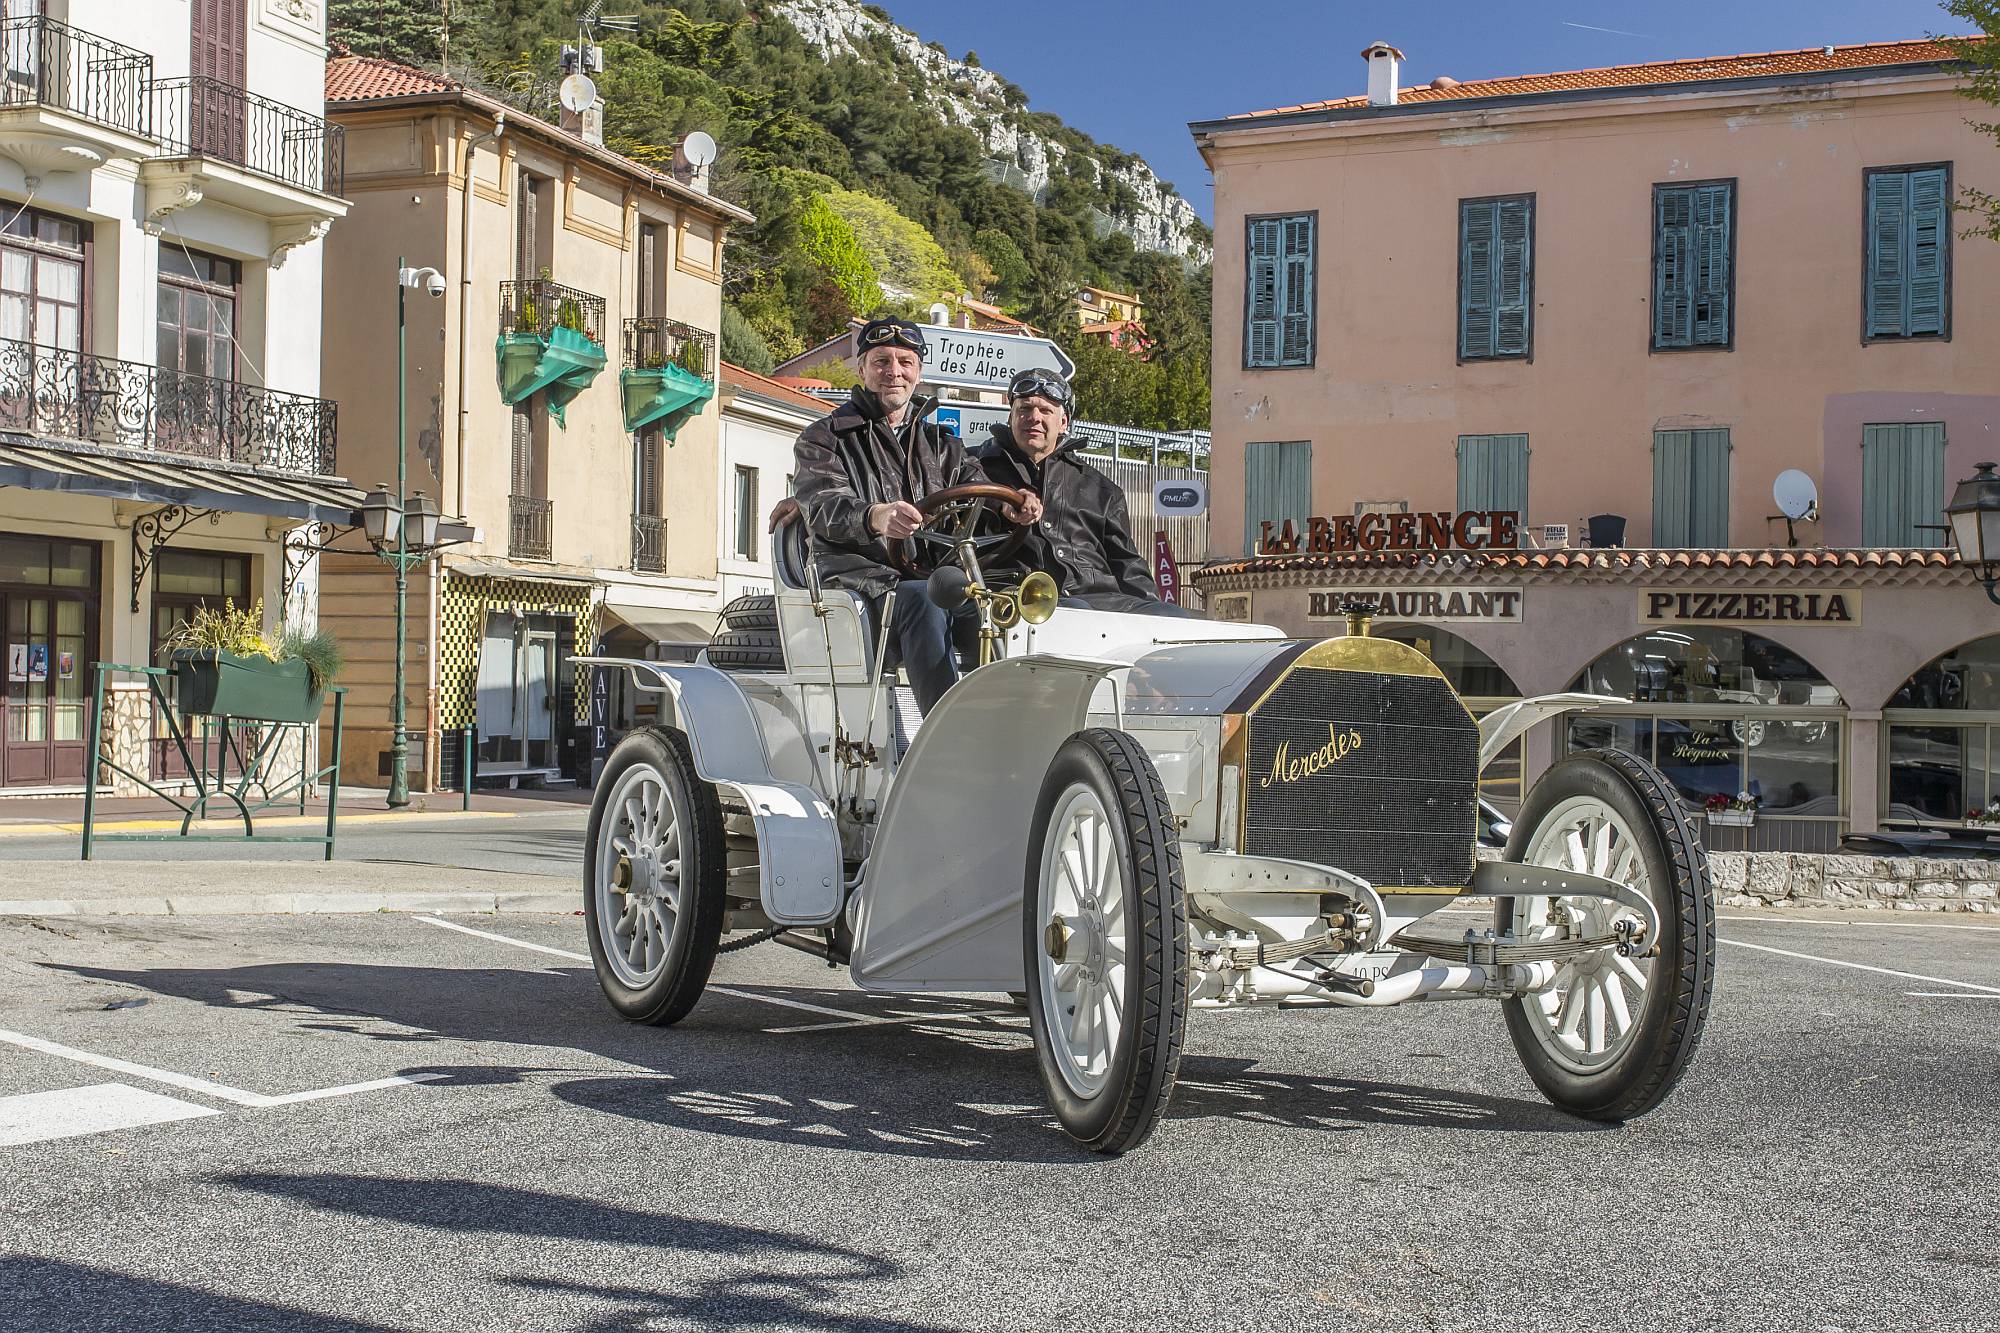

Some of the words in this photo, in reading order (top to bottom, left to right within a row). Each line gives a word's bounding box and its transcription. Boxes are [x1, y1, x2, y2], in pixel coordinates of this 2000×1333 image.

[940, 338, 1004, 360] Trophée
[940, 357, 967, 374] des
[974, 360, 1016, 381] Alpes
[1260, 518, 1299, 555] LA
[1306, 510, 1519, 553] REGENCE
[1157, 541, 1175, 603] TABA
[1647, 592, 1852, 621] PIZZERIA
[1692, 730, 1710, 745] La
[1261, 722, 1362, 788] Mercedes
[1373, 966, 1389, 983] PS
